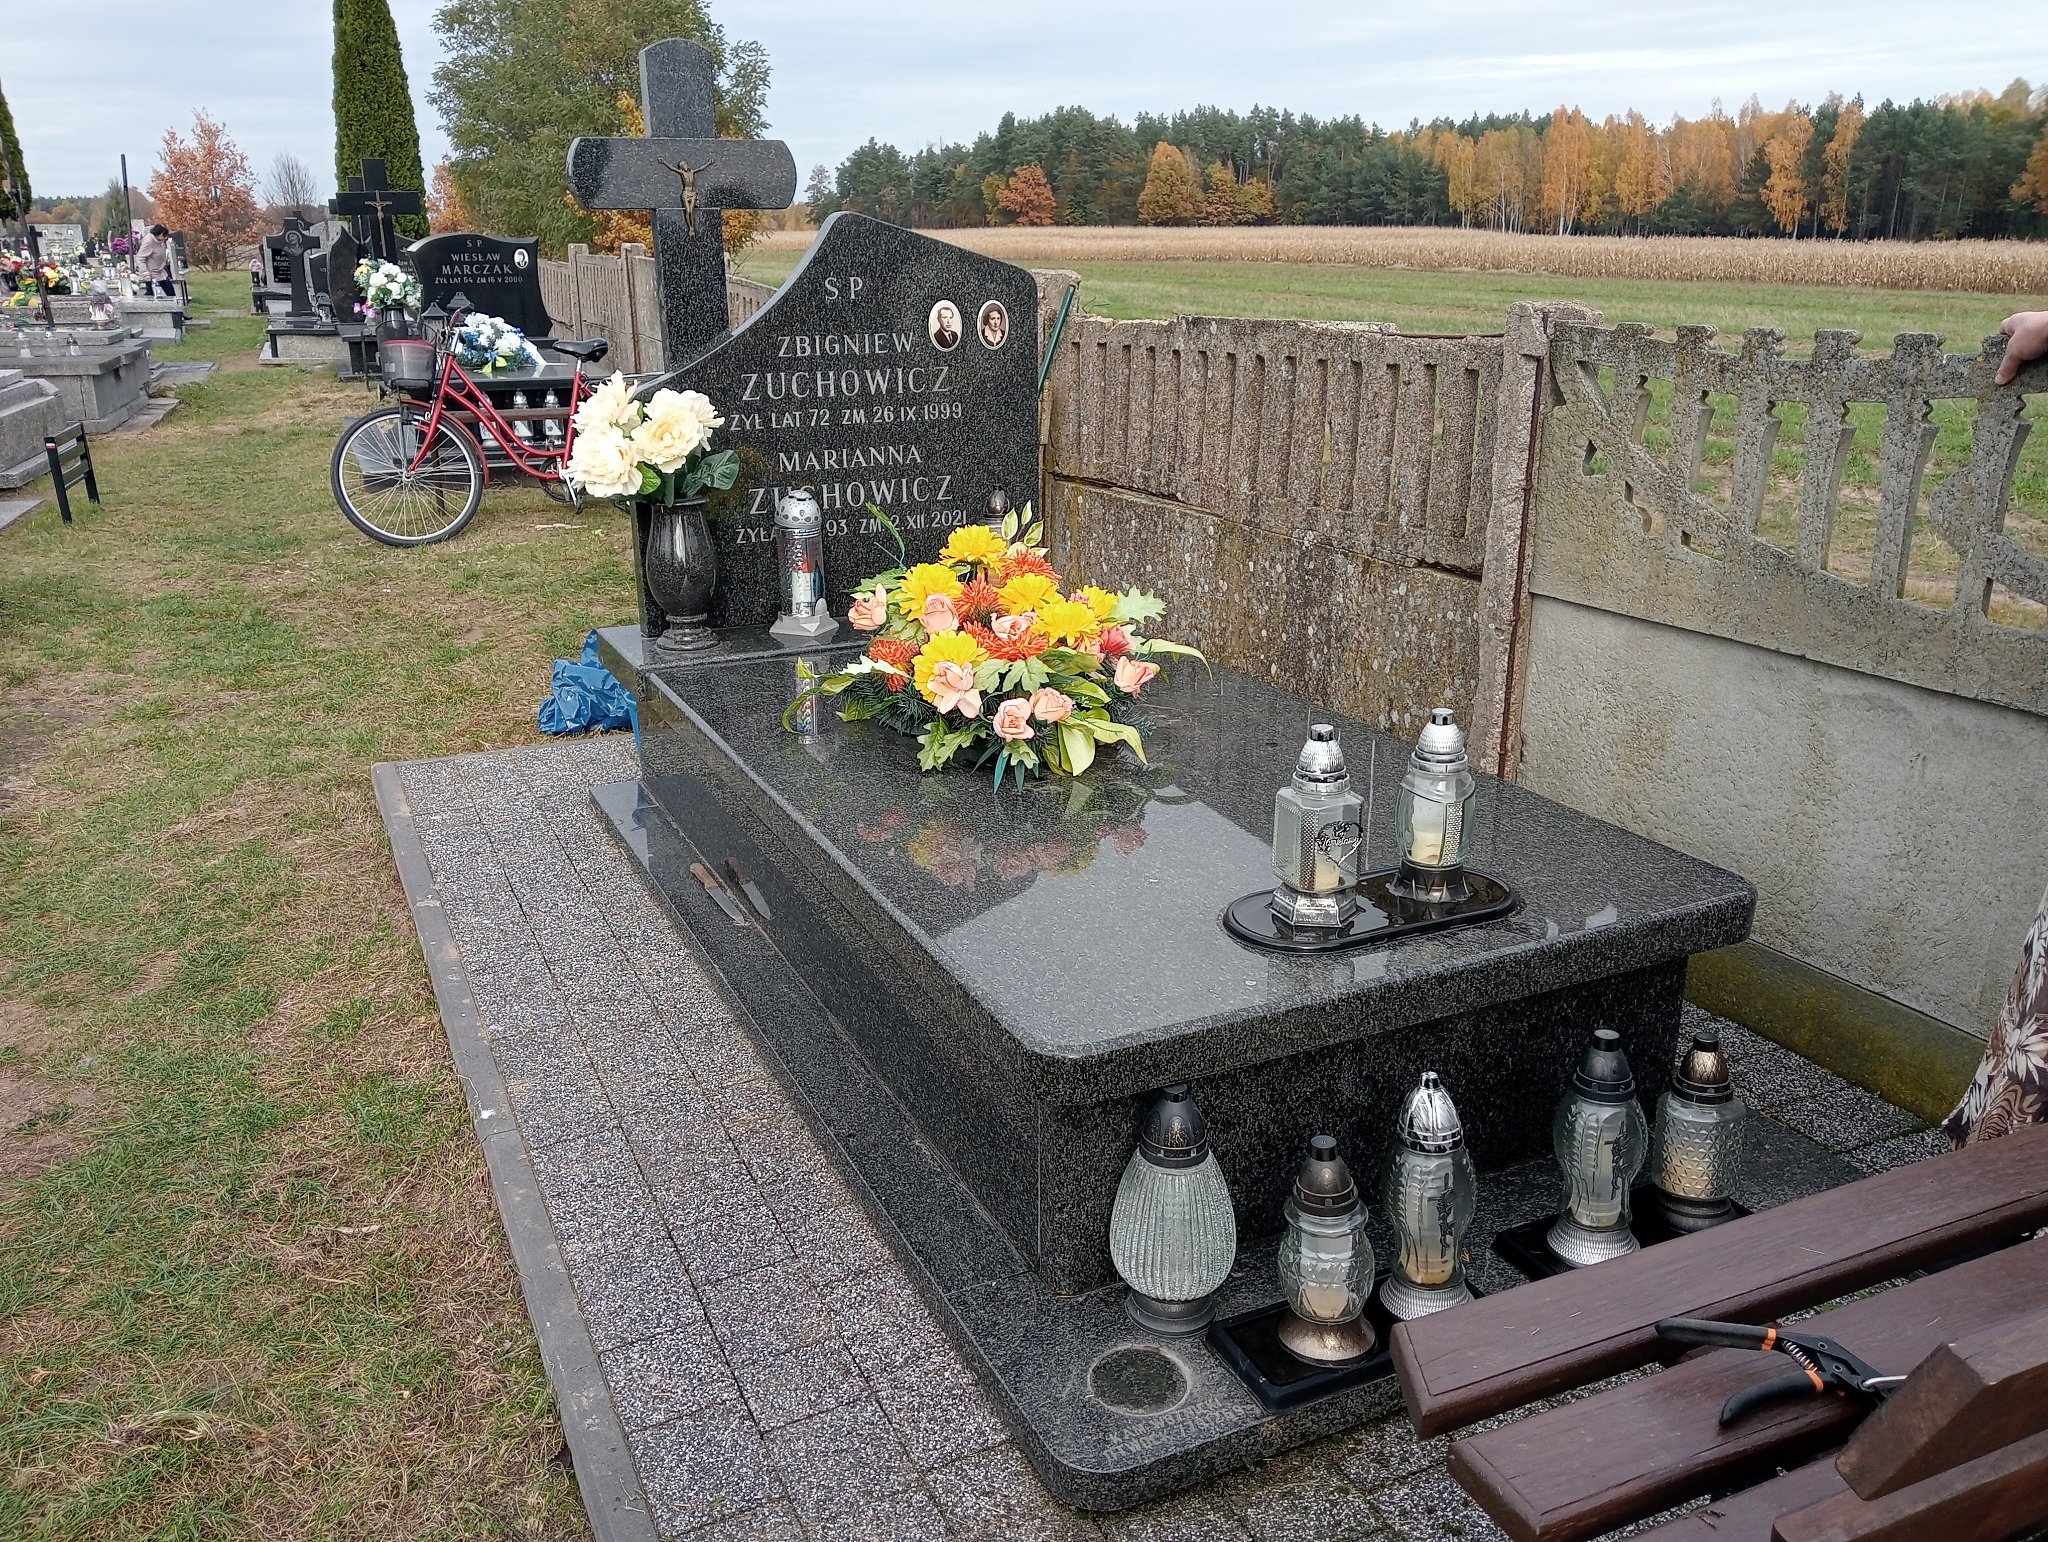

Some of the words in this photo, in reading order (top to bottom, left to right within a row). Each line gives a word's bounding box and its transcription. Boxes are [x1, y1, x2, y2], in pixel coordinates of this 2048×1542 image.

[451, 253, 500, 262] WIESŁAW
[442, 264, 513, 275] MARCZAK
[777, 332, 914, 357] ZBIGNIEW
[741, 366, 950, 401] ZUCHOWICZ
[771, 411, 802, 429] LAT
[809, 408, 830, 427] 72
[778, 445, 922, 472] MARIANNA
[825, 519, 848, 537] 93
